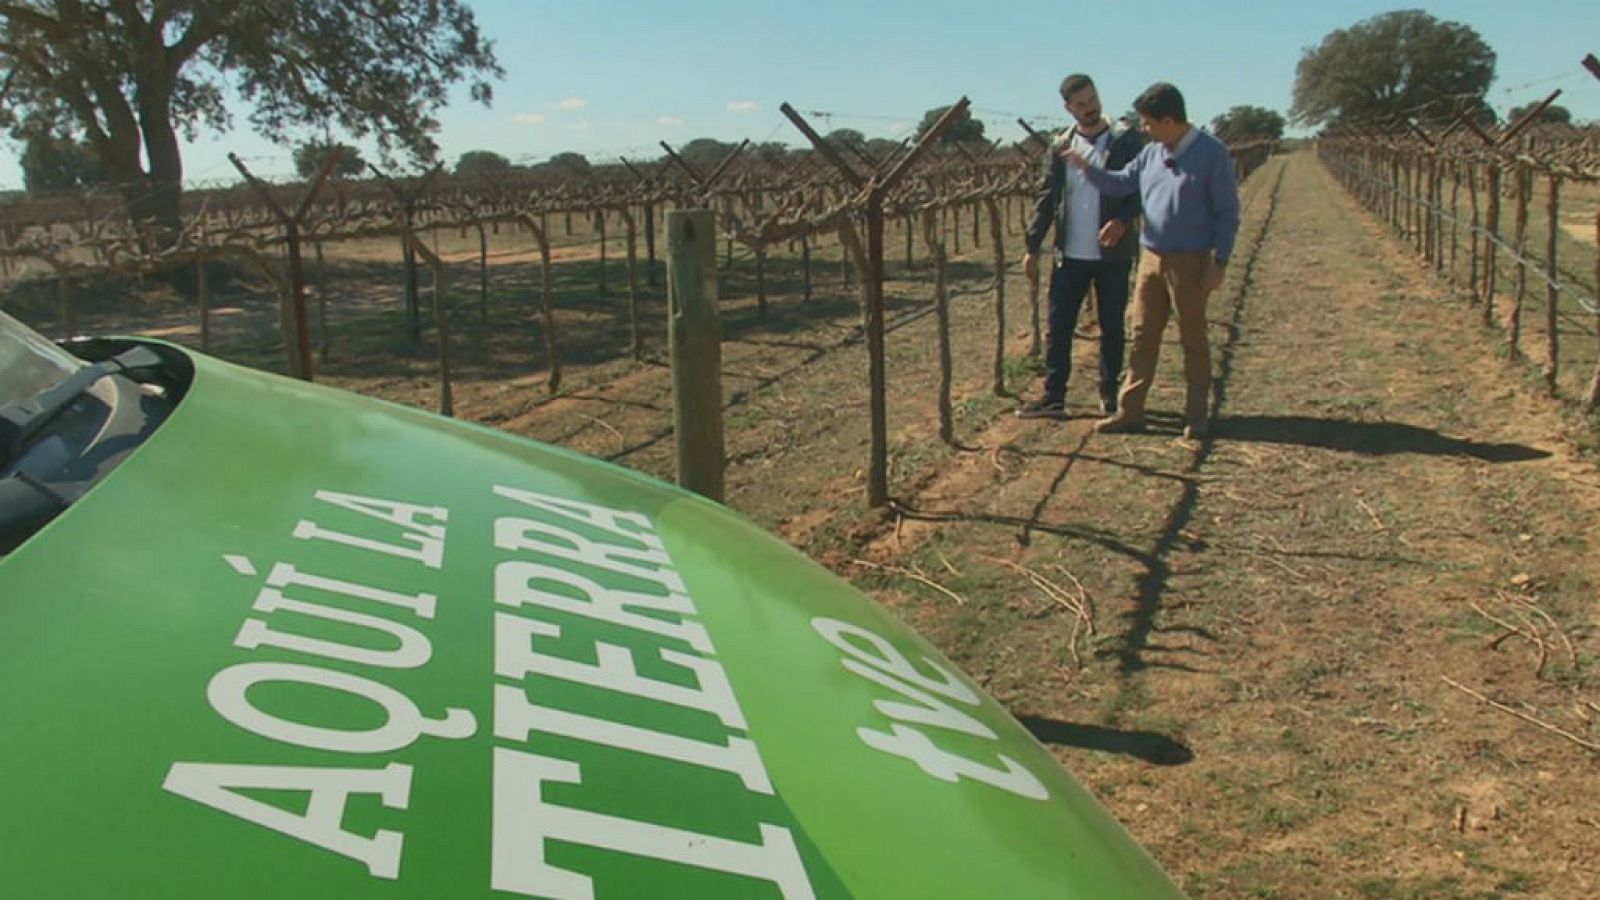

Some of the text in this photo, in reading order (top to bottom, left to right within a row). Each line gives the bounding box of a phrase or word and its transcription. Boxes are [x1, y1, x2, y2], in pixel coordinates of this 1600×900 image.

[161, 488, 478, 880] AQUÍ LA
[490, 484, 817, 900] TIERRA
